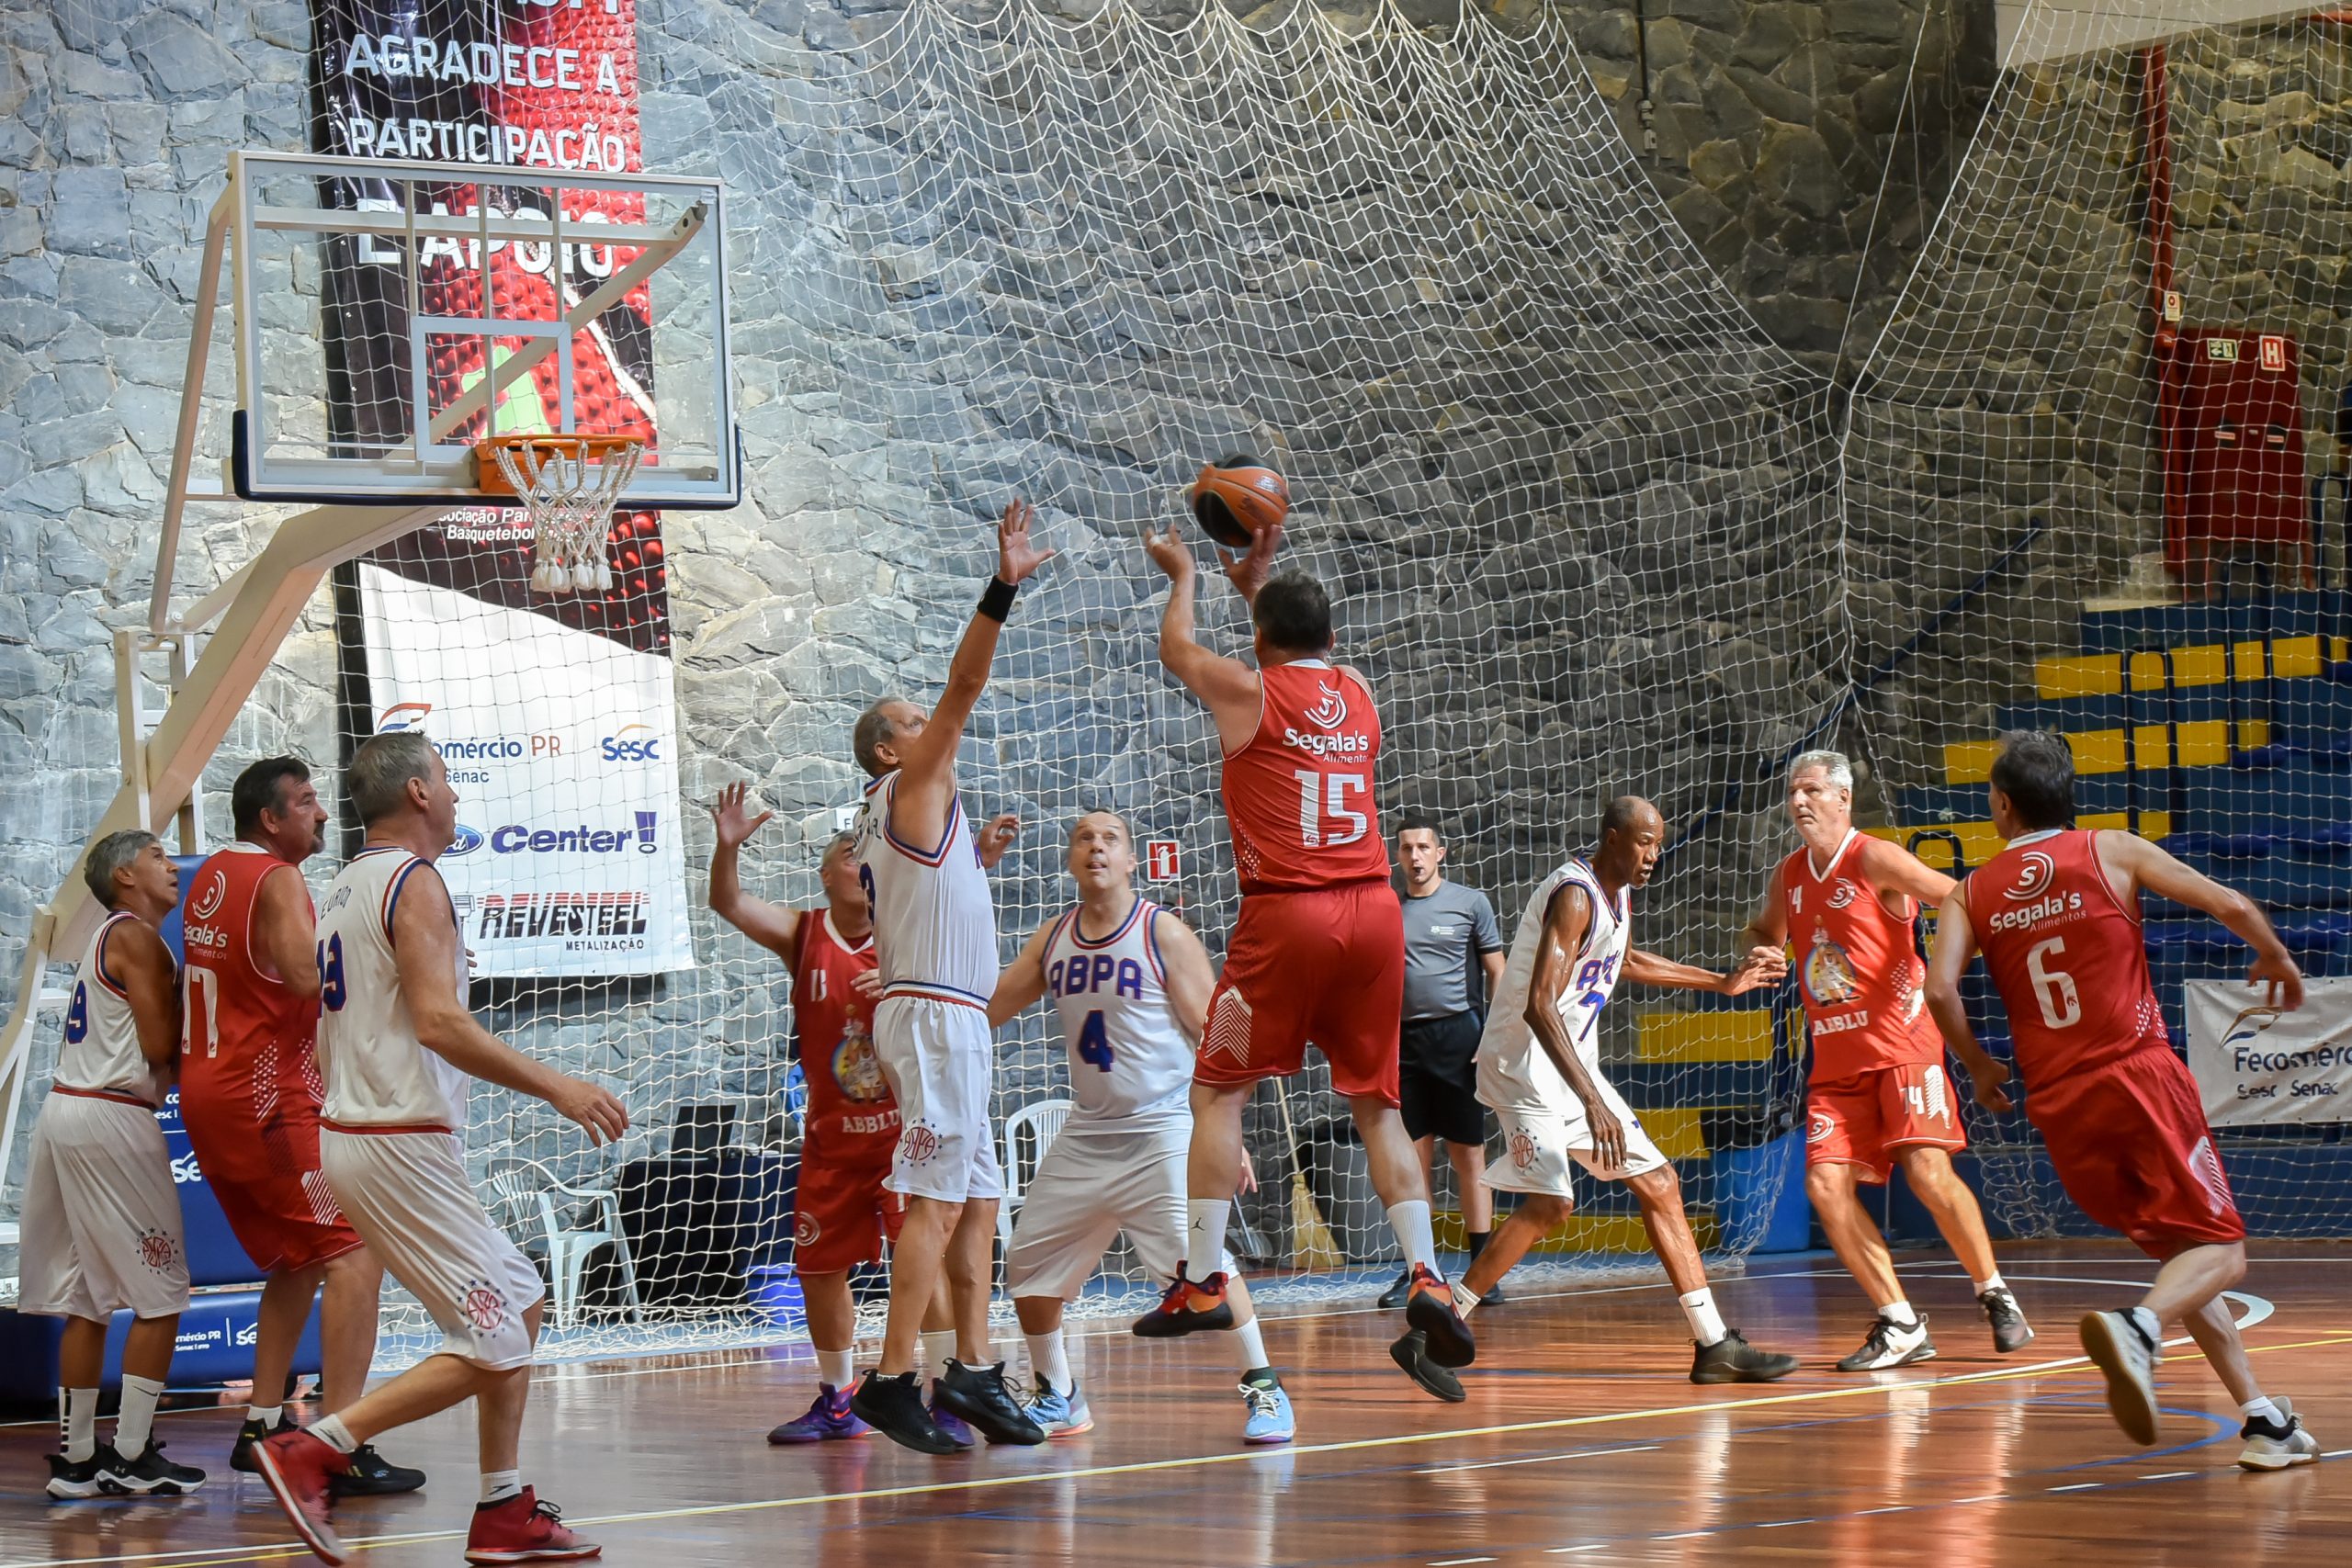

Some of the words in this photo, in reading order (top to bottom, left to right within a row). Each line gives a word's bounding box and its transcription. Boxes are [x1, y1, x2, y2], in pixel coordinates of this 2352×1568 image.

[345, 33, 582, 91] AGRADECE
[597, 52, 623, 96] A
[349, 116, 626, 175] PARTICIPAÇÃO
[357, 198, 401, 265] E
[2265, 342, 2280, 365] H
[447, 525, 535, 544] Basquetebol
[531, 736, 561, 757] PR
[602, 737, 660, 761] Sesc
[1283, 728, 1369, 755] Segala's
[1294, 769, 1367, 847] 15
[492, 811, 658, 854] Center!
[478, 892, 650, 939] REVESTEEL
[1989, 890, 2083, 934] Segala's
[2029, 909, 2087, 934] Alimentos
[565, 937, 644, 953] METALIZAÇÃO
[1050, 953, 1143, 1001] ABPA
[2027, 935, 2082, 1030] 6
[1577, 989, 1606, 1043] 7
[1079, 1009, 1114, 1073] 4
[2290, 1079, 2340, 1098] Senac
